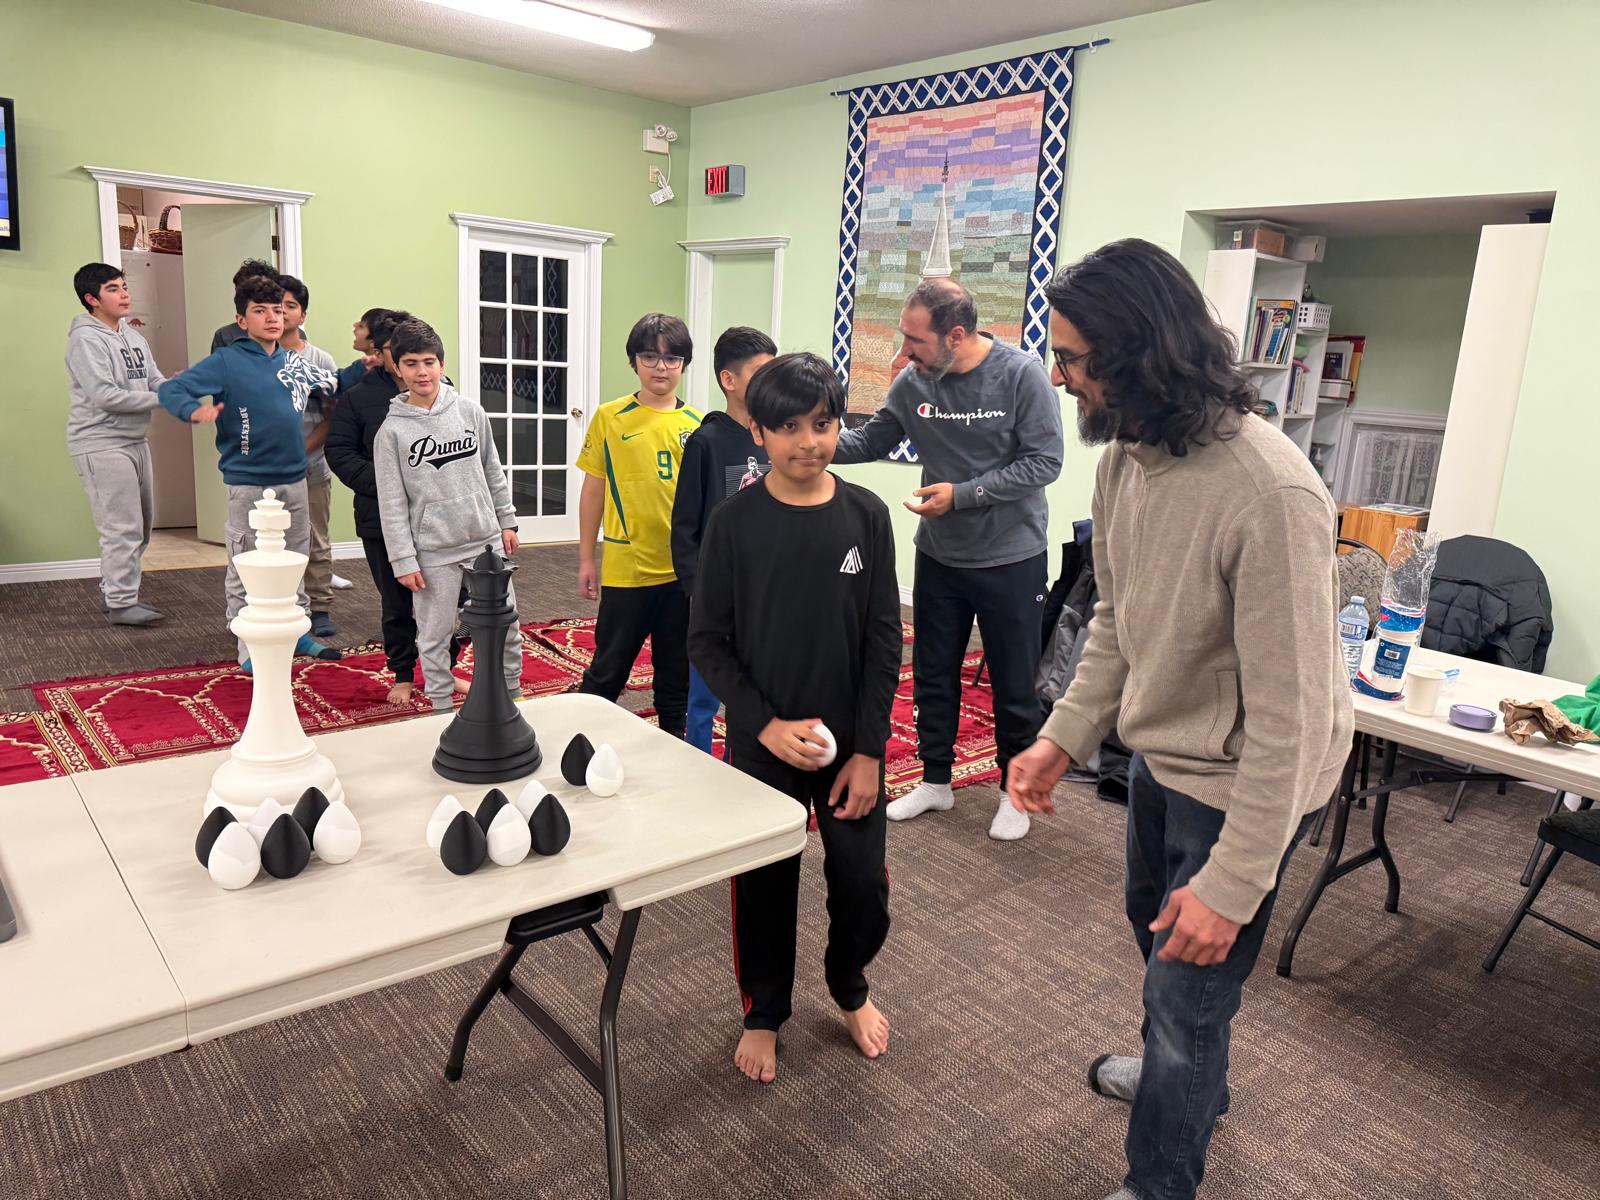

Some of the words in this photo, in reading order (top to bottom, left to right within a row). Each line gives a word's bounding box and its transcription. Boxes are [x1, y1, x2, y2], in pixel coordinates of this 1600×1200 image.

[708, 165, 727, 194] EXIT
[120, 347, 145, 369] GP
[917, 403, 1006, 425] Champion
[408, 434, 475, 467] Puma
[657, 450, 673, 480] 9
